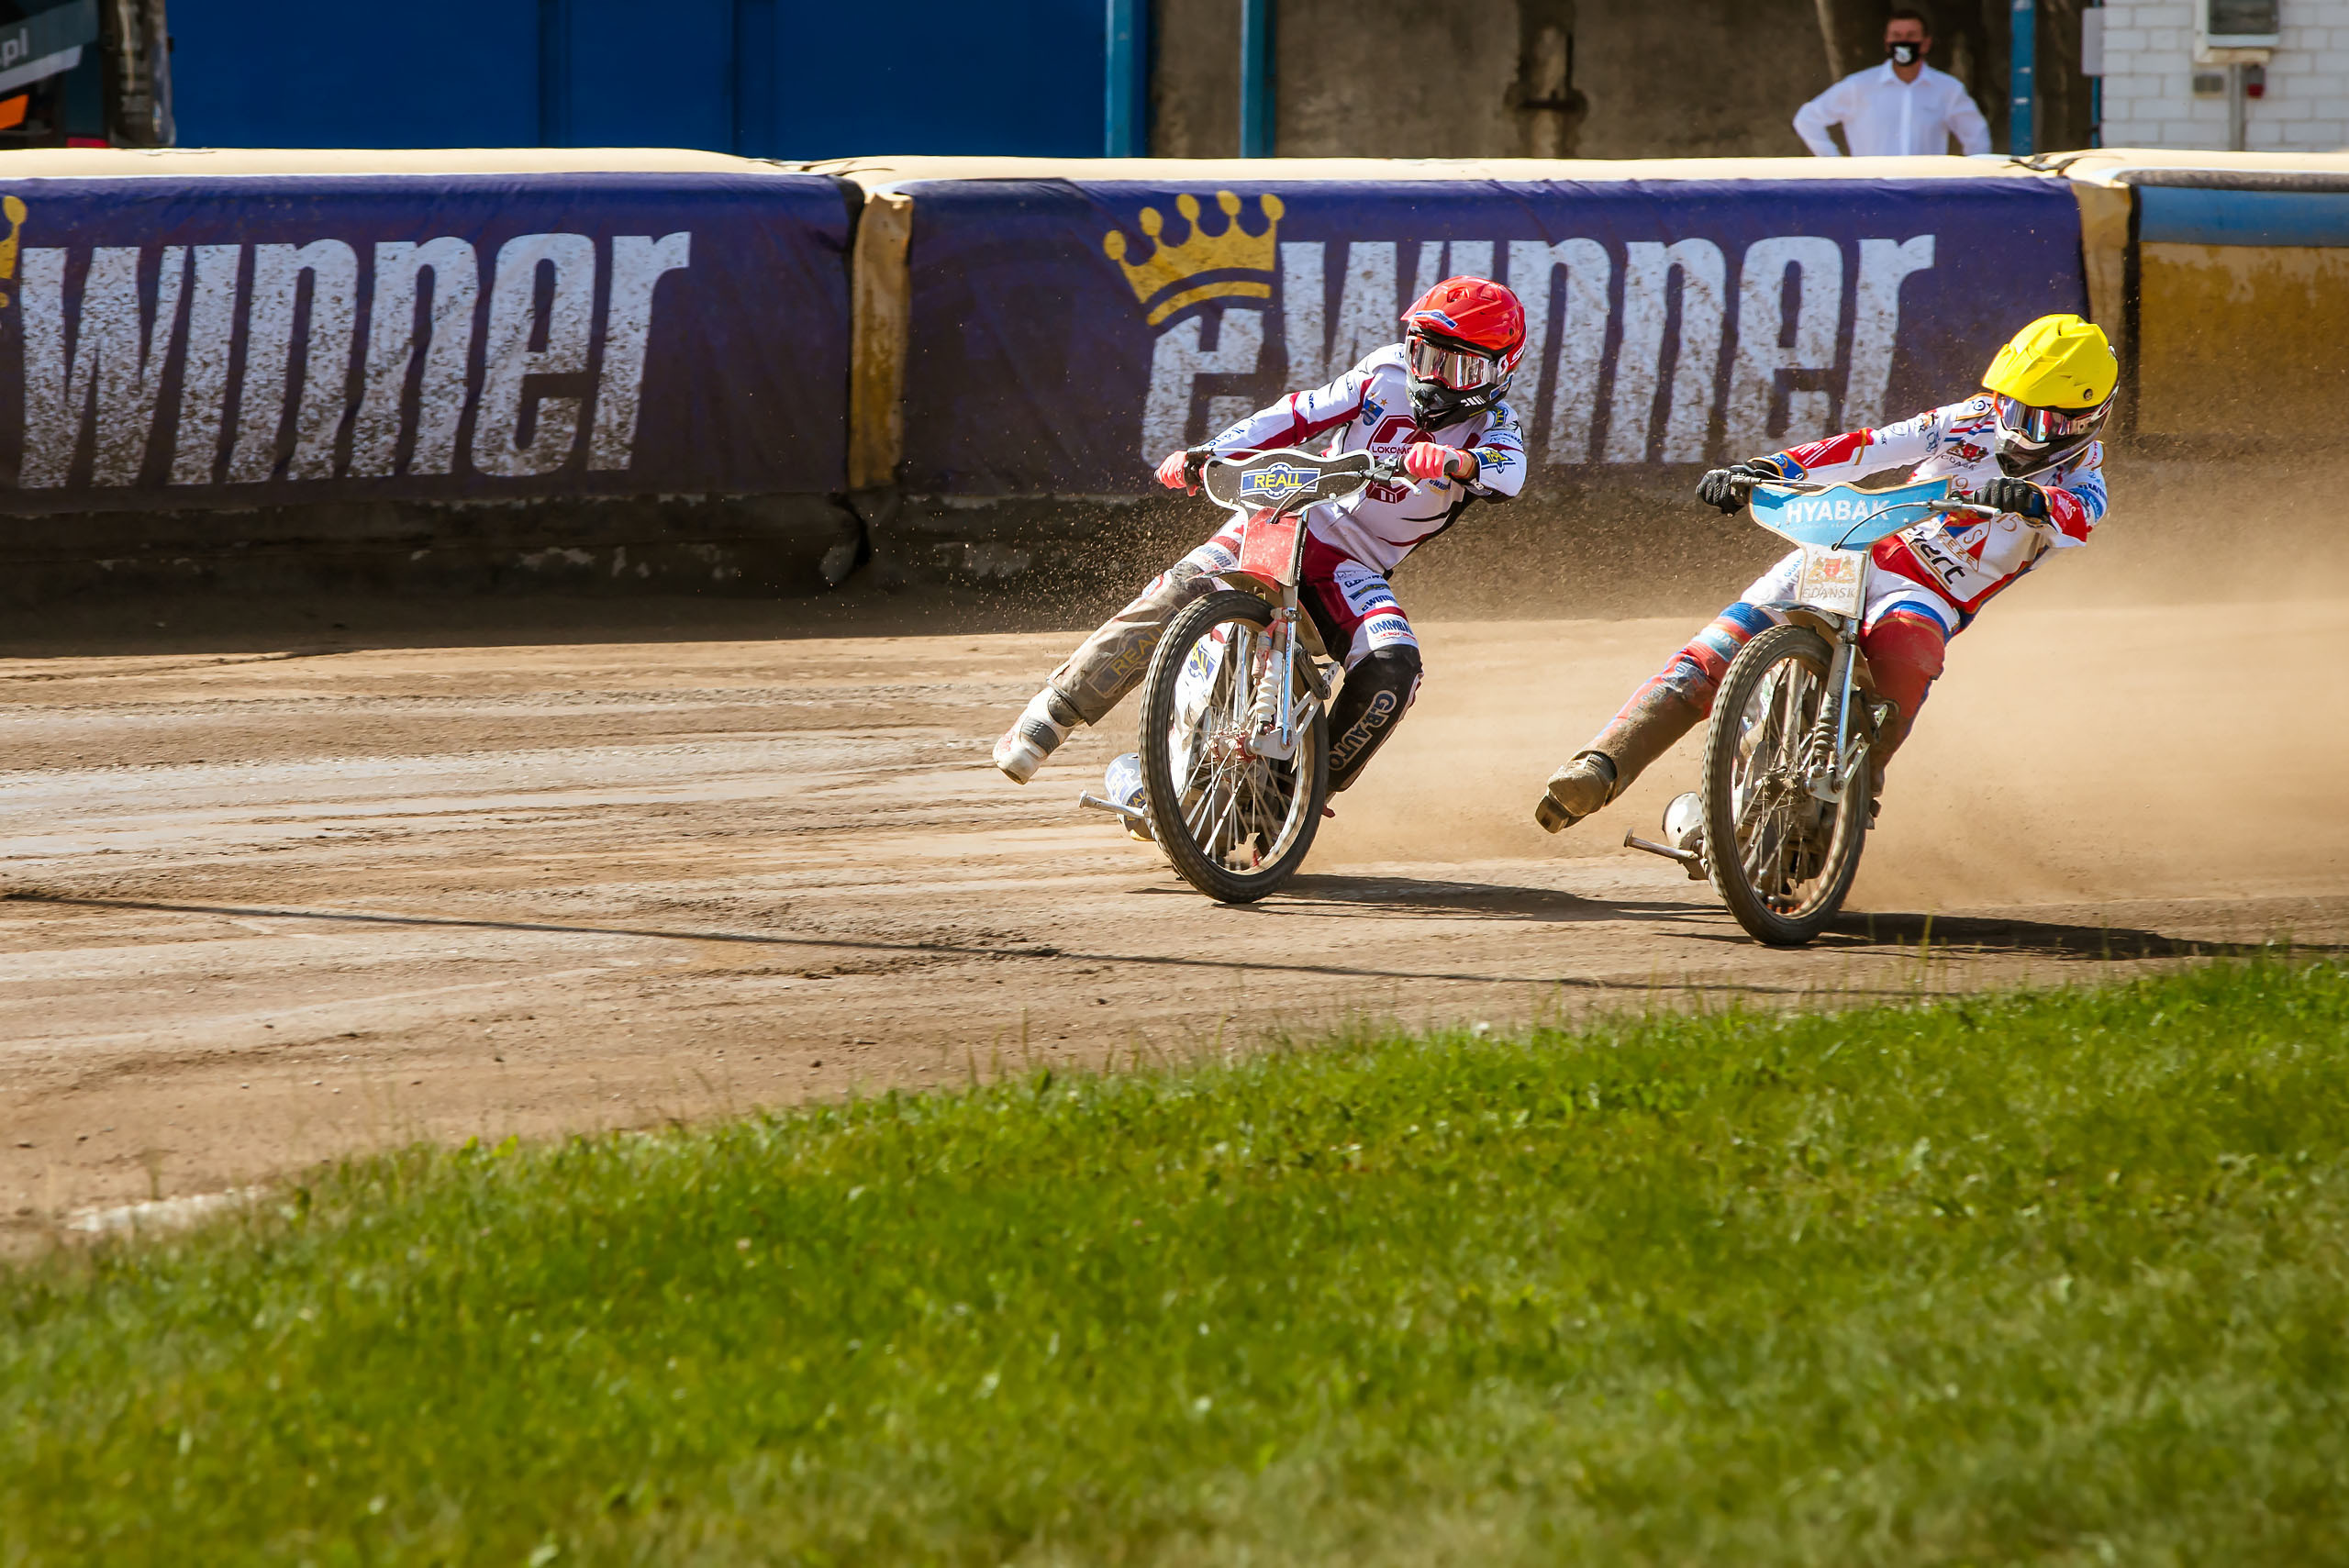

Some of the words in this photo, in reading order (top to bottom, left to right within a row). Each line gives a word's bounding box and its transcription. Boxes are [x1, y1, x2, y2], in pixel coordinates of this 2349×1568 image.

[1140, 234, 1935, 469] eWnner
[1253, 473, 1303, 488] REALL
[1787, 498, 1892, 523] HYABAK
